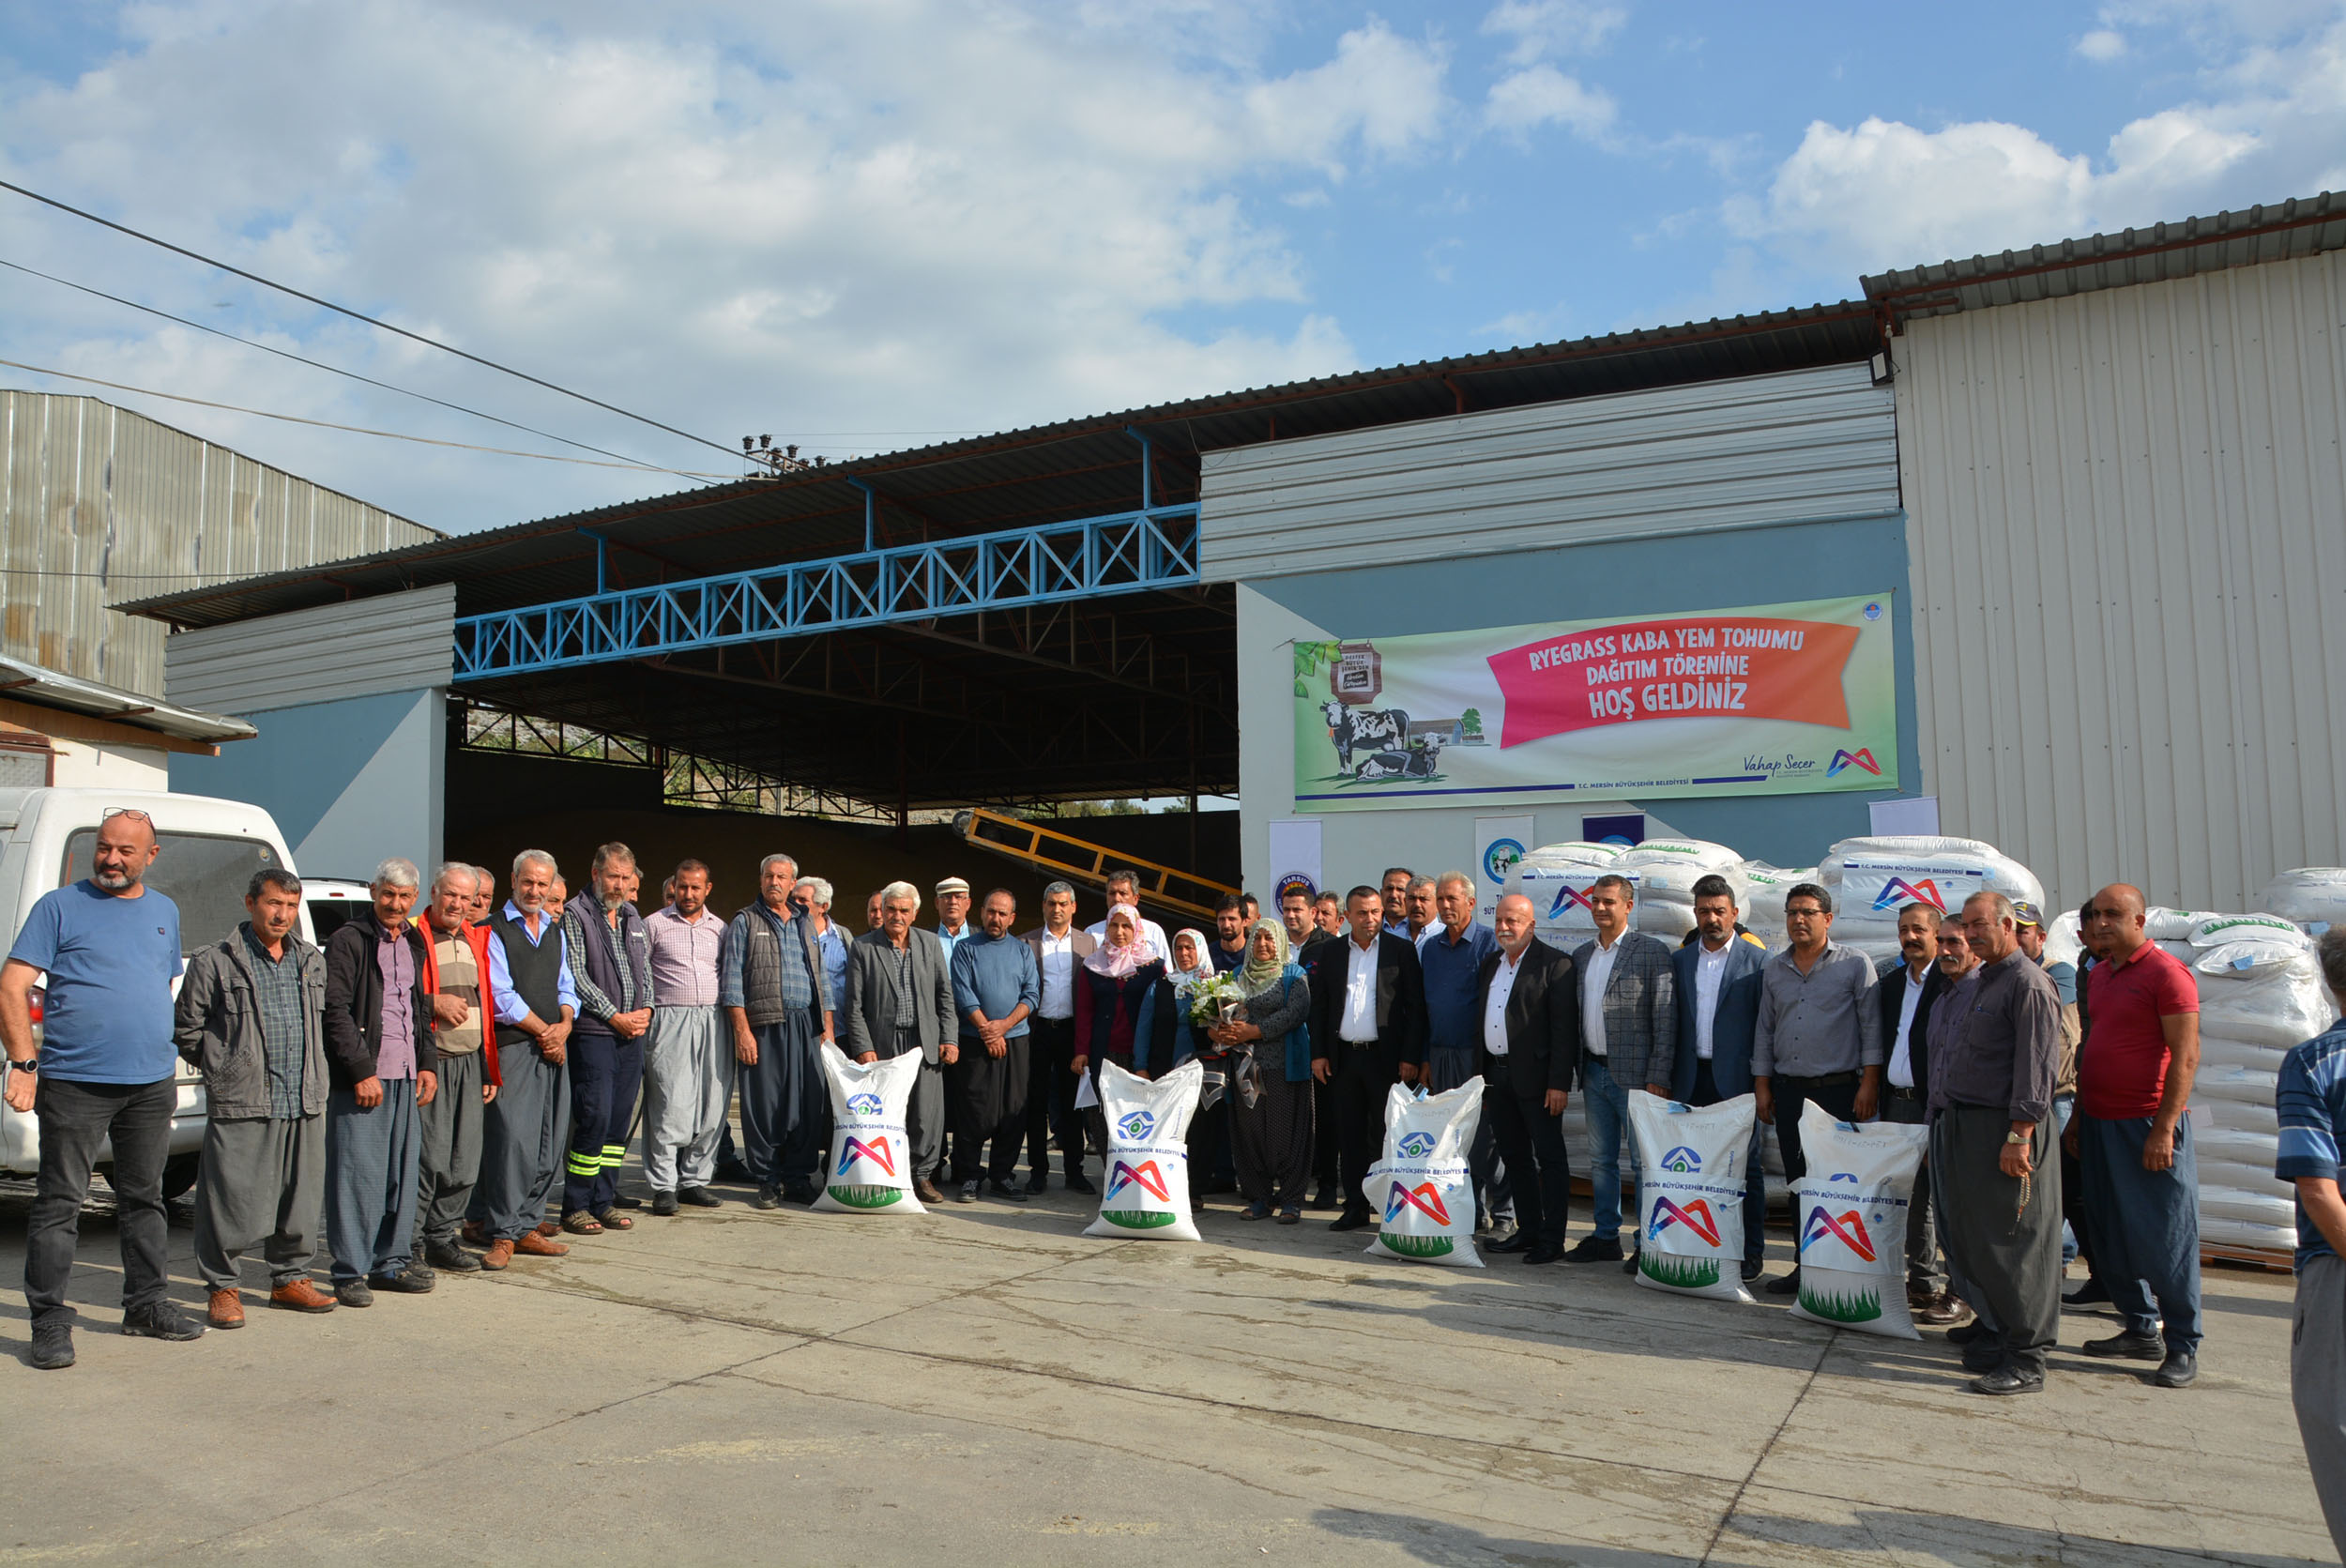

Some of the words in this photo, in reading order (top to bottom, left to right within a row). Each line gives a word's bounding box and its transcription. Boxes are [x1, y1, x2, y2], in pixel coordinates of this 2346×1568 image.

[1529, 635, 1616, 671] RYEGRASS
[1622, 630, 1669, 653] KABA
[1674, 628, 1714, 648] YEM
[1721, 627, 1805, 651] TOHUMU
[1586, 659, 1657, 686] DAĞITIM
[1663, 650, 1749, 677] TÖRENİNE
[1588, 686, 1635, 720] HOŞ
[1642, 676, 1748, 711] GELDİNİZ
[1744, 754, 1782, 777] Vahap
[1615, 780, 1654, 788] BÜYÜKŞEHİR
[1656, 778, 1689, 786] BELEDİYESİ
[1895, 863, 1931, 874] BÜYÜKŞEHİR
[1932, 867, 1964, 875] BELEDİYESİ
[1282, 875, 1310, 887] TARSUS
[1484, 905, 1495, 916] SÜT
[1662, 1181, 1703, 1191] BÜYÜKŞEHİR
[1705, 1185, 1736, 1196] BELEDİYESİ
[1820, 1191, 1860, 1203] BÜYÜKŞEHİR
[1862, 1195, 1894, 1206] BELEDİYESİ
